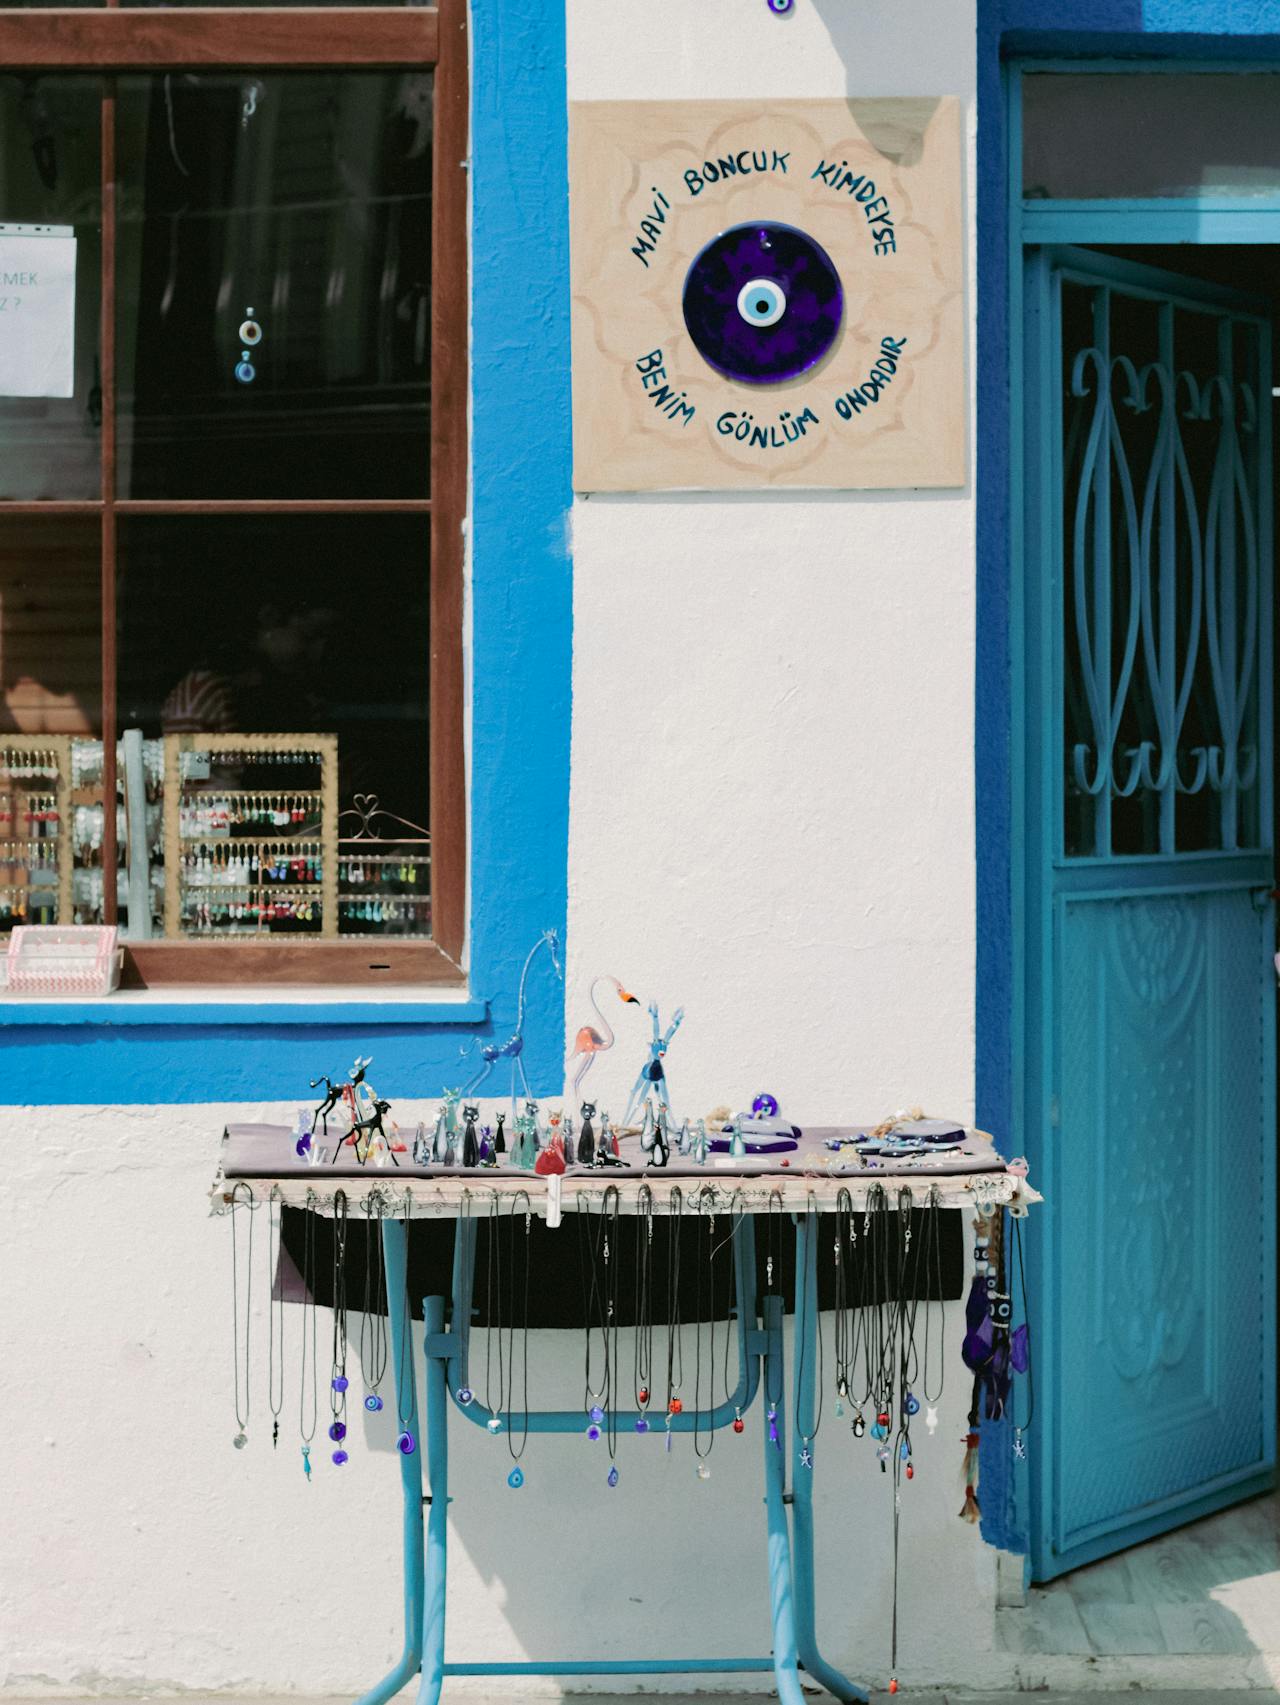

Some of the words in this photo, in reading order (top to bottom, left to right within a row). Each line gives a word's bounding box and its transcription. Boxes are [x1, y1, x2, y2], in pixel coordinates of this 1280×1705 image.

[631, 186, 670, 268] MAVİ
[683, 150, 791, 196] BONCUK
[810, 160, 897, 256] KİMDEYSE
[0, 271, 39, 286] MEK
[635, 348, 696, 427] BENİM
[716, 407, 820, 449] GÖNLÜM
[835, 336, 907, 421] ONDADIR
